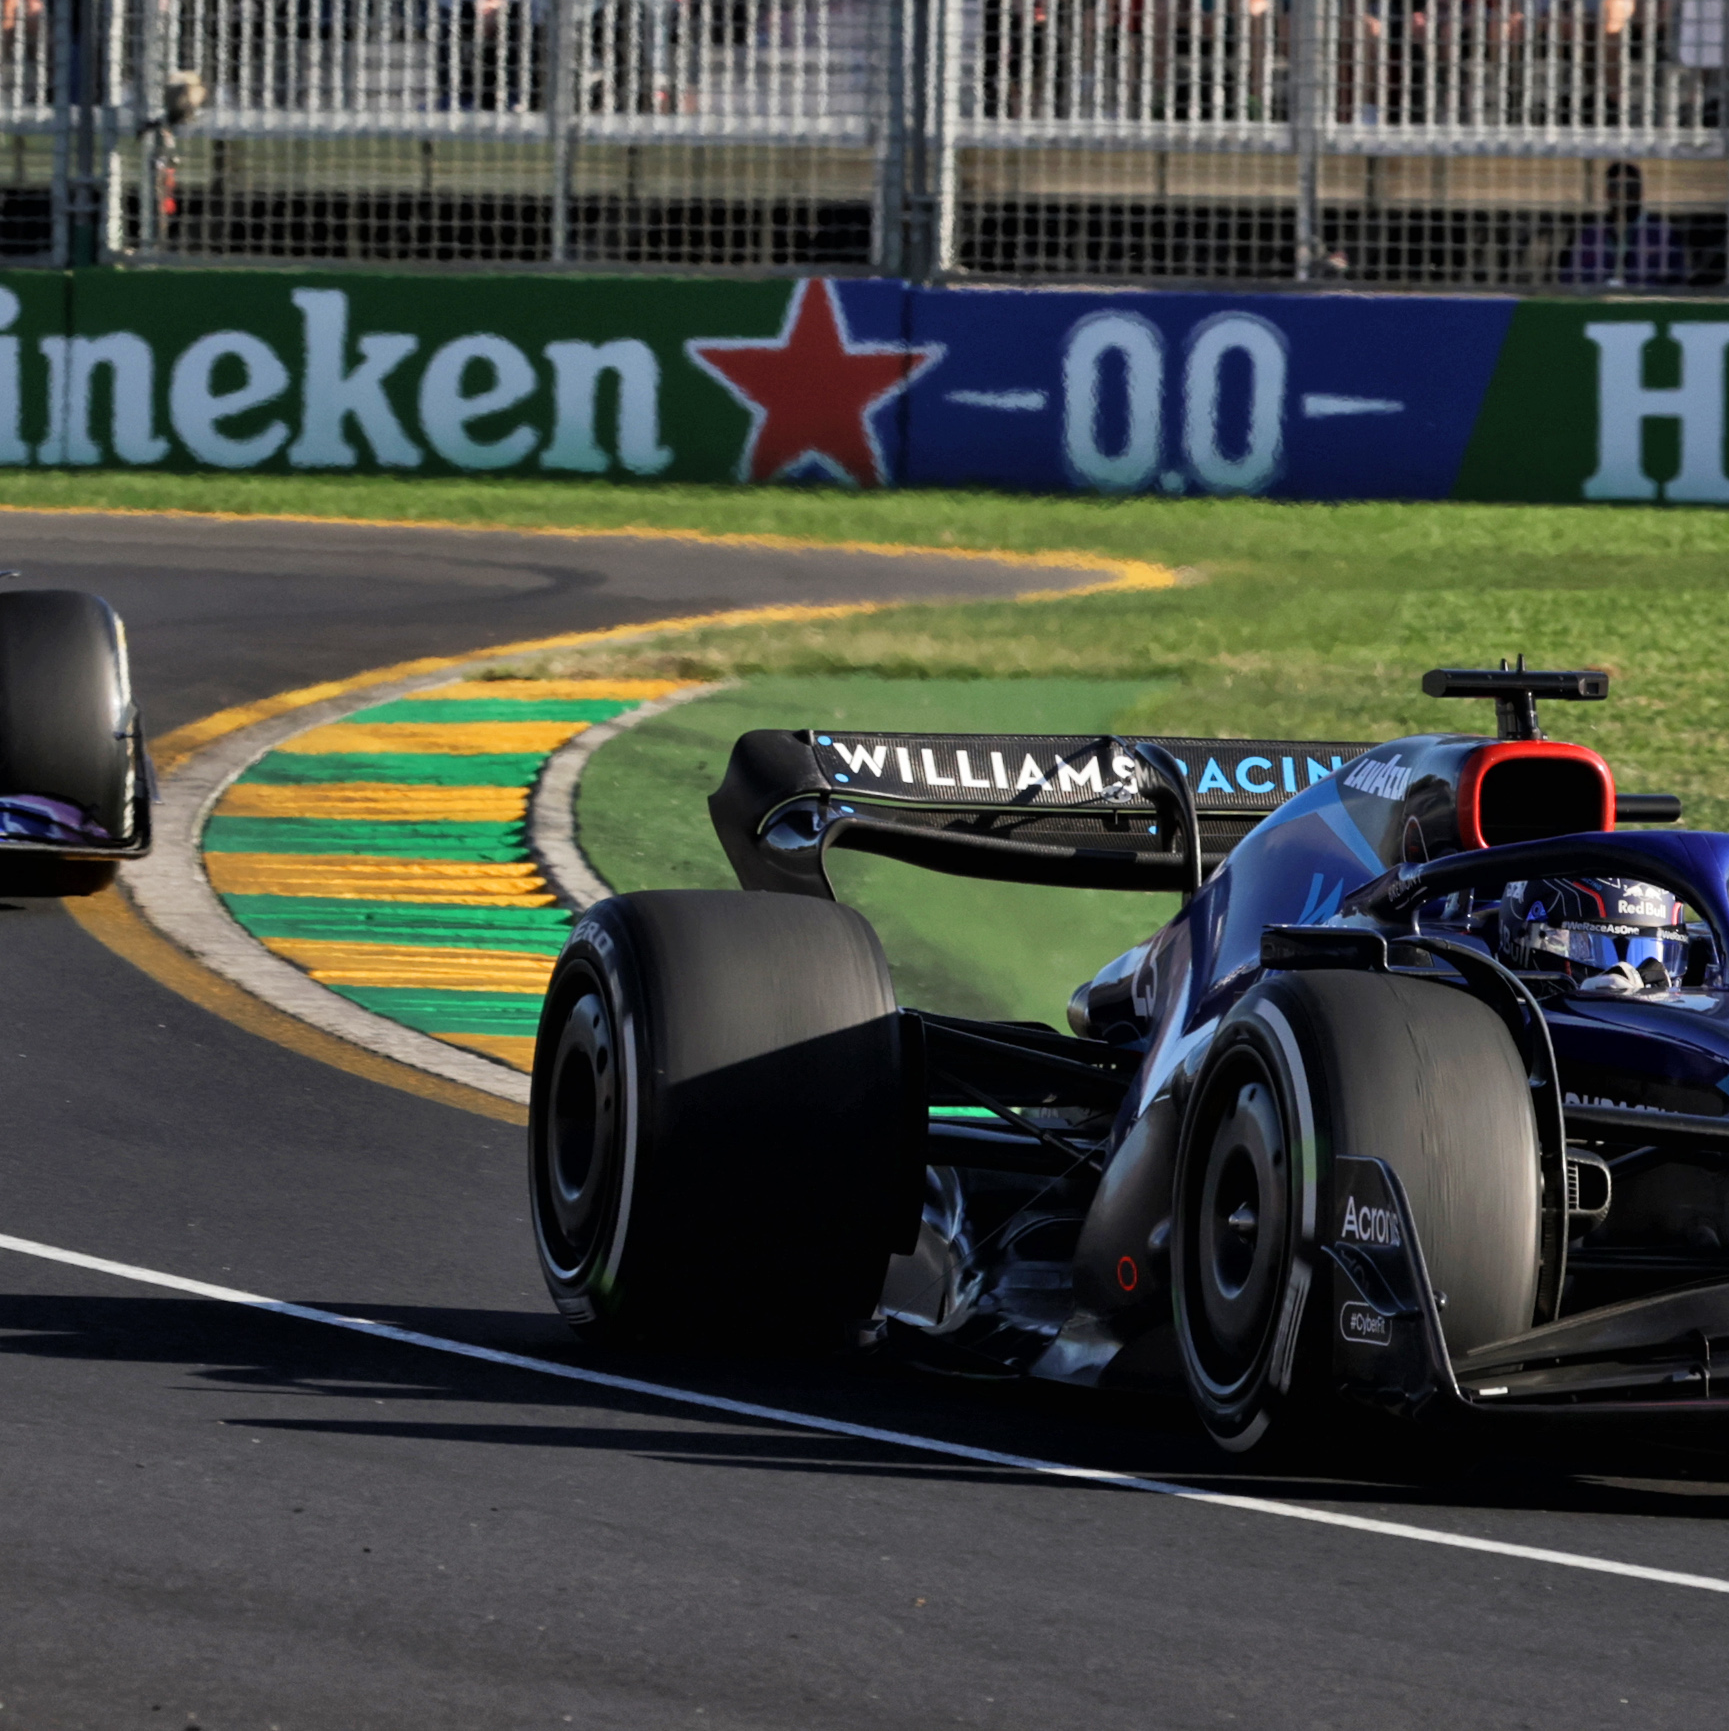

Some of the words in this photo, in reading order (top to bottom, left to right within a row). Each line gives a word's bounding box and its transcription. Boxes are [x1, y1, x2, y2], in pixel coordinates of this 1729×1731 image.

[1062, 311, 1289, 493] 0.0
[832, 742, 1138, 795] WILLIAMS
[1343, 753, 1413, 802] LAVAZZA
[1618, 899, 1644, 915] Red
[1645, 902, 1666, 919] Bull
[1561, 920, 1640, 936] #WeRaceAsOne
[1350, 1312, 1387, 1336] #CyberFit
